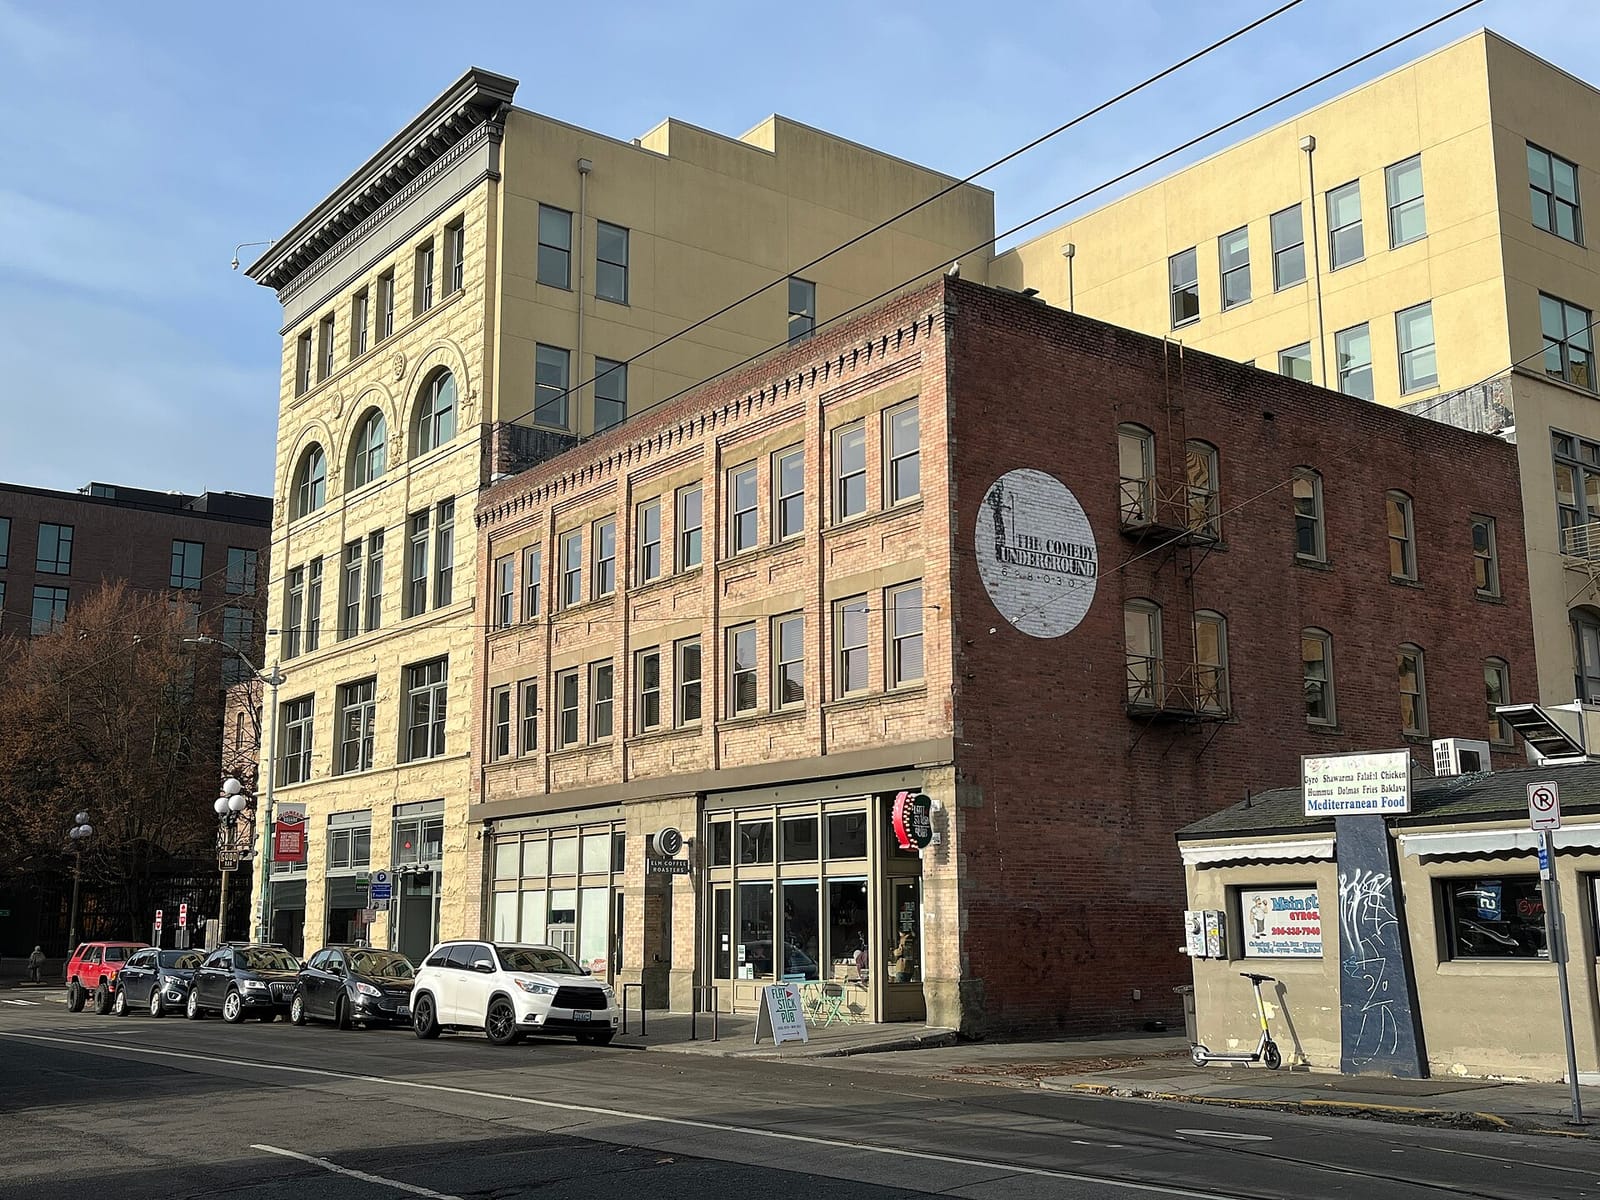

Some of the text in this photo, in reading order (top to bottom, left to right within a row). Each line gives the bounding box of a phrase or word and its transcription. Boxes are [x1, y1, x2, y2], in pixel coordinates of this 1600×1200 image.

[1046, 539, 1094, 560] COMEDY
[1000, 547, 1095, 577] UNDERGROUND
[1323, 774, 1354, 783] Shawarma
[1381, 770, 1406, 780] Chicken
[1362, 785, 1378, 794] Fries
[1381, 784, 1406, 793] Baklava
[1307, 796, 1405, 811] Mediterranean Food
[1270, 895, 1305, 911] Main
[771, 987, 786, 999] FLAT
[777, 999, 797, 1010] STICK
[780, 1011, 796, 1023] PUB
